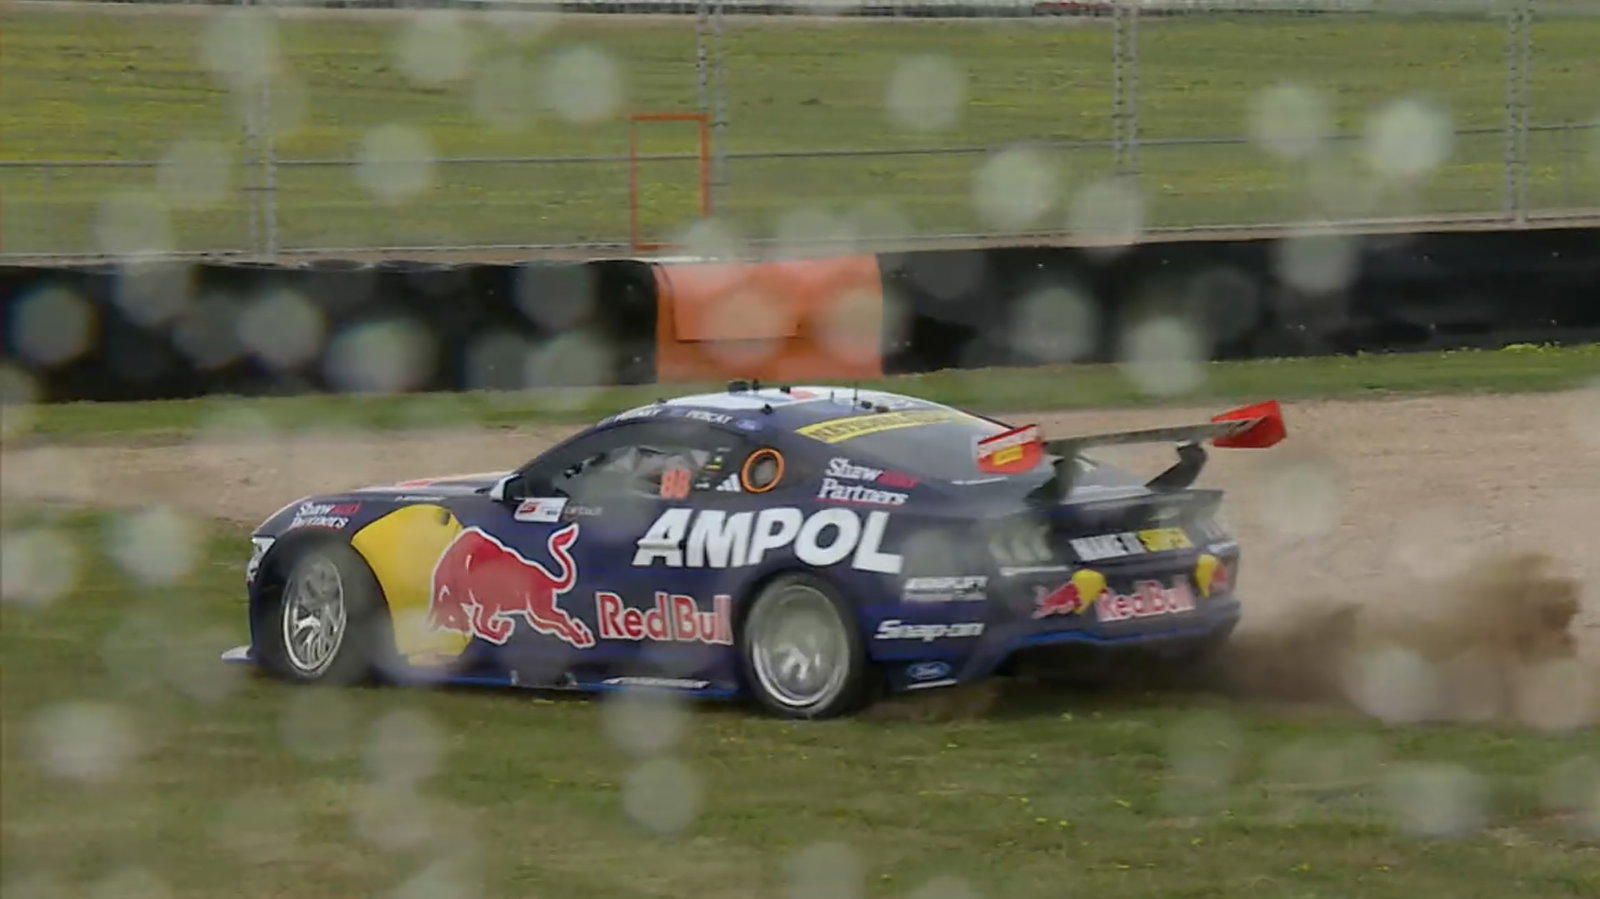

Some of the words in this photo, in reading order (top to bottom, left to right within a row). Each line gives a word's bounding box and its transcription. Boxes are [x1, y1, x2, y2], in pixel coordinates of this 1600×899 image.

[659, 468, 692, 499] 88
[825, 458, 884, 481] Shaw
[817, 478, 909, 505] Partners
[632, 507, 903, 574] AMPOL
[595, 591, 673, 640] Red
[670, 595, 734, 646] Bull
